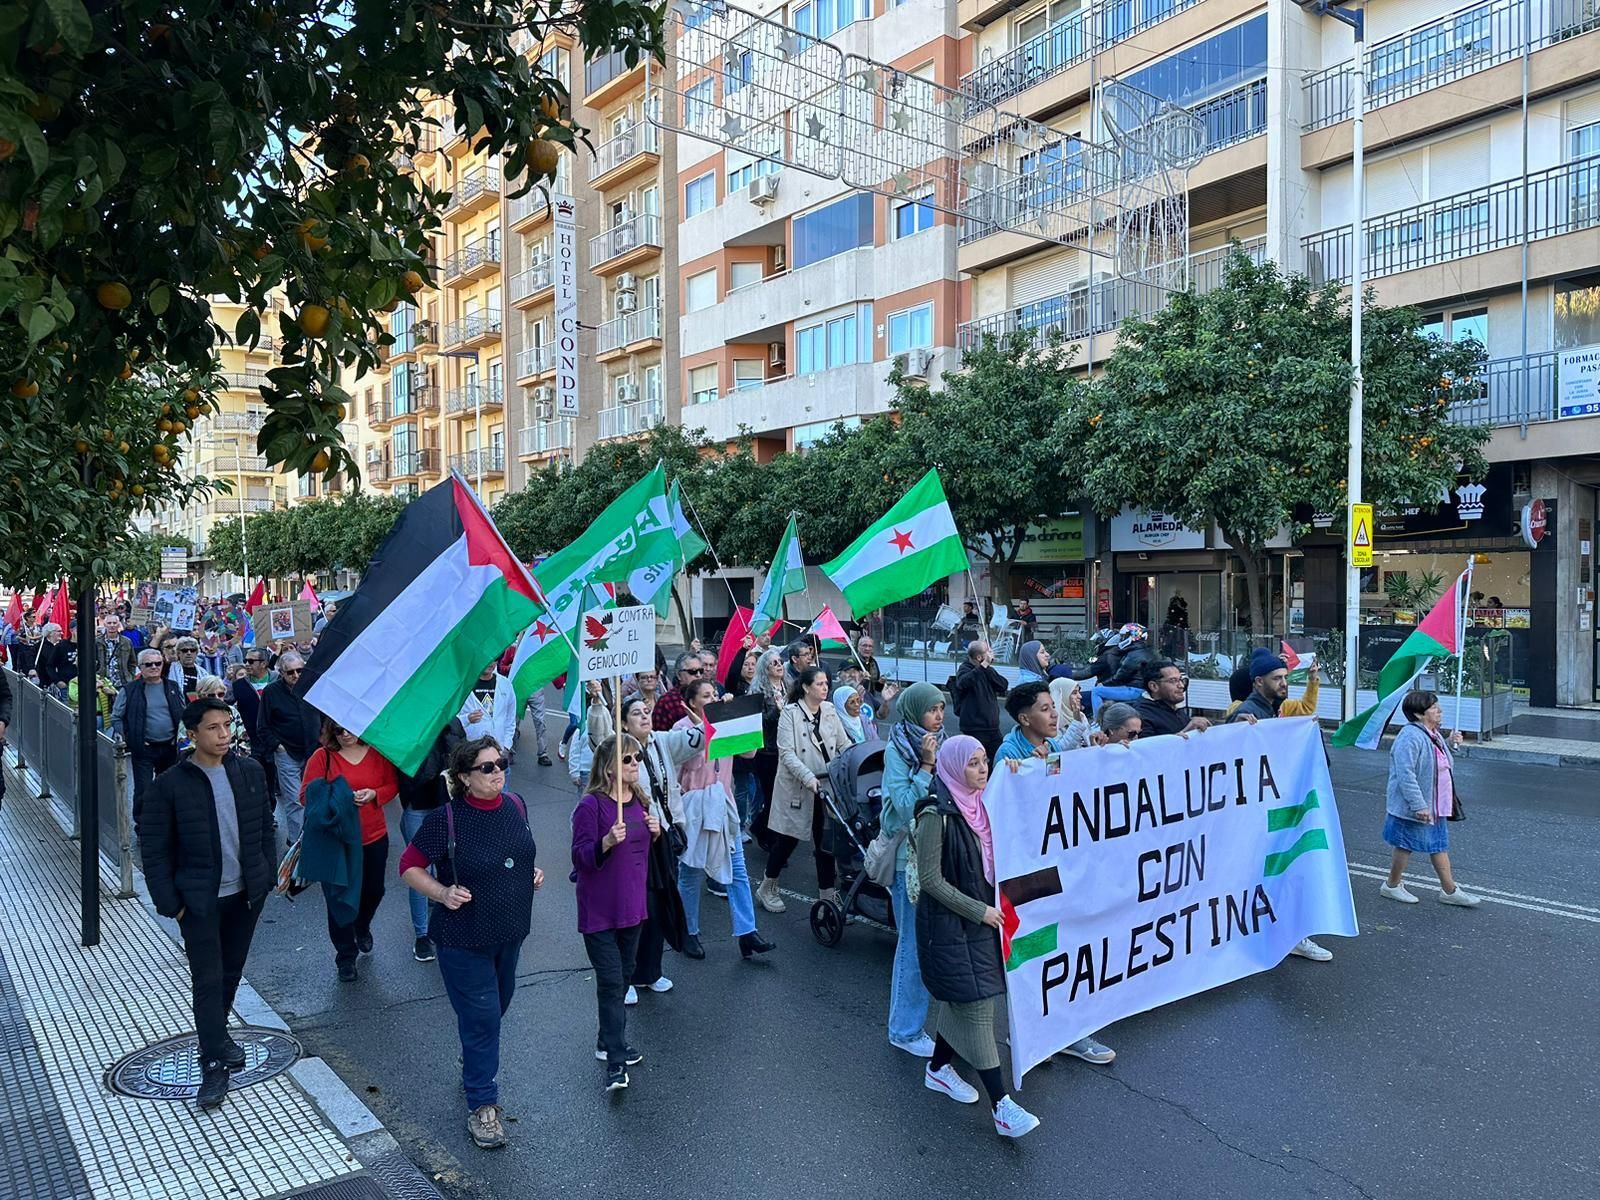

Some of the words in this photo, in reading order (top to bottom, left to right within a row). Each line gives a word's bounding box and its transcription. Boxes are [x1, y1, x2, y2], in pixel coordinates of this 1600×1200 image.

[560, 233, 572, 299] HOTEL
[560, 318, 576, 409] CONDE
[1038, 528, 1081, 542] doñana
[1132, 522, 1183, 533] ALAMEDA
[618, 607, 653, 623] CONTRA
[627, 629, 639, 642] EL
[588, 650, 638, 671] GENOCIDIO
[1040, 753, 1281, 856] ANDALUCIA
[1136, 834, 1206, 903] CON
[1041, 883, 1278, 1017] PALESTINA
